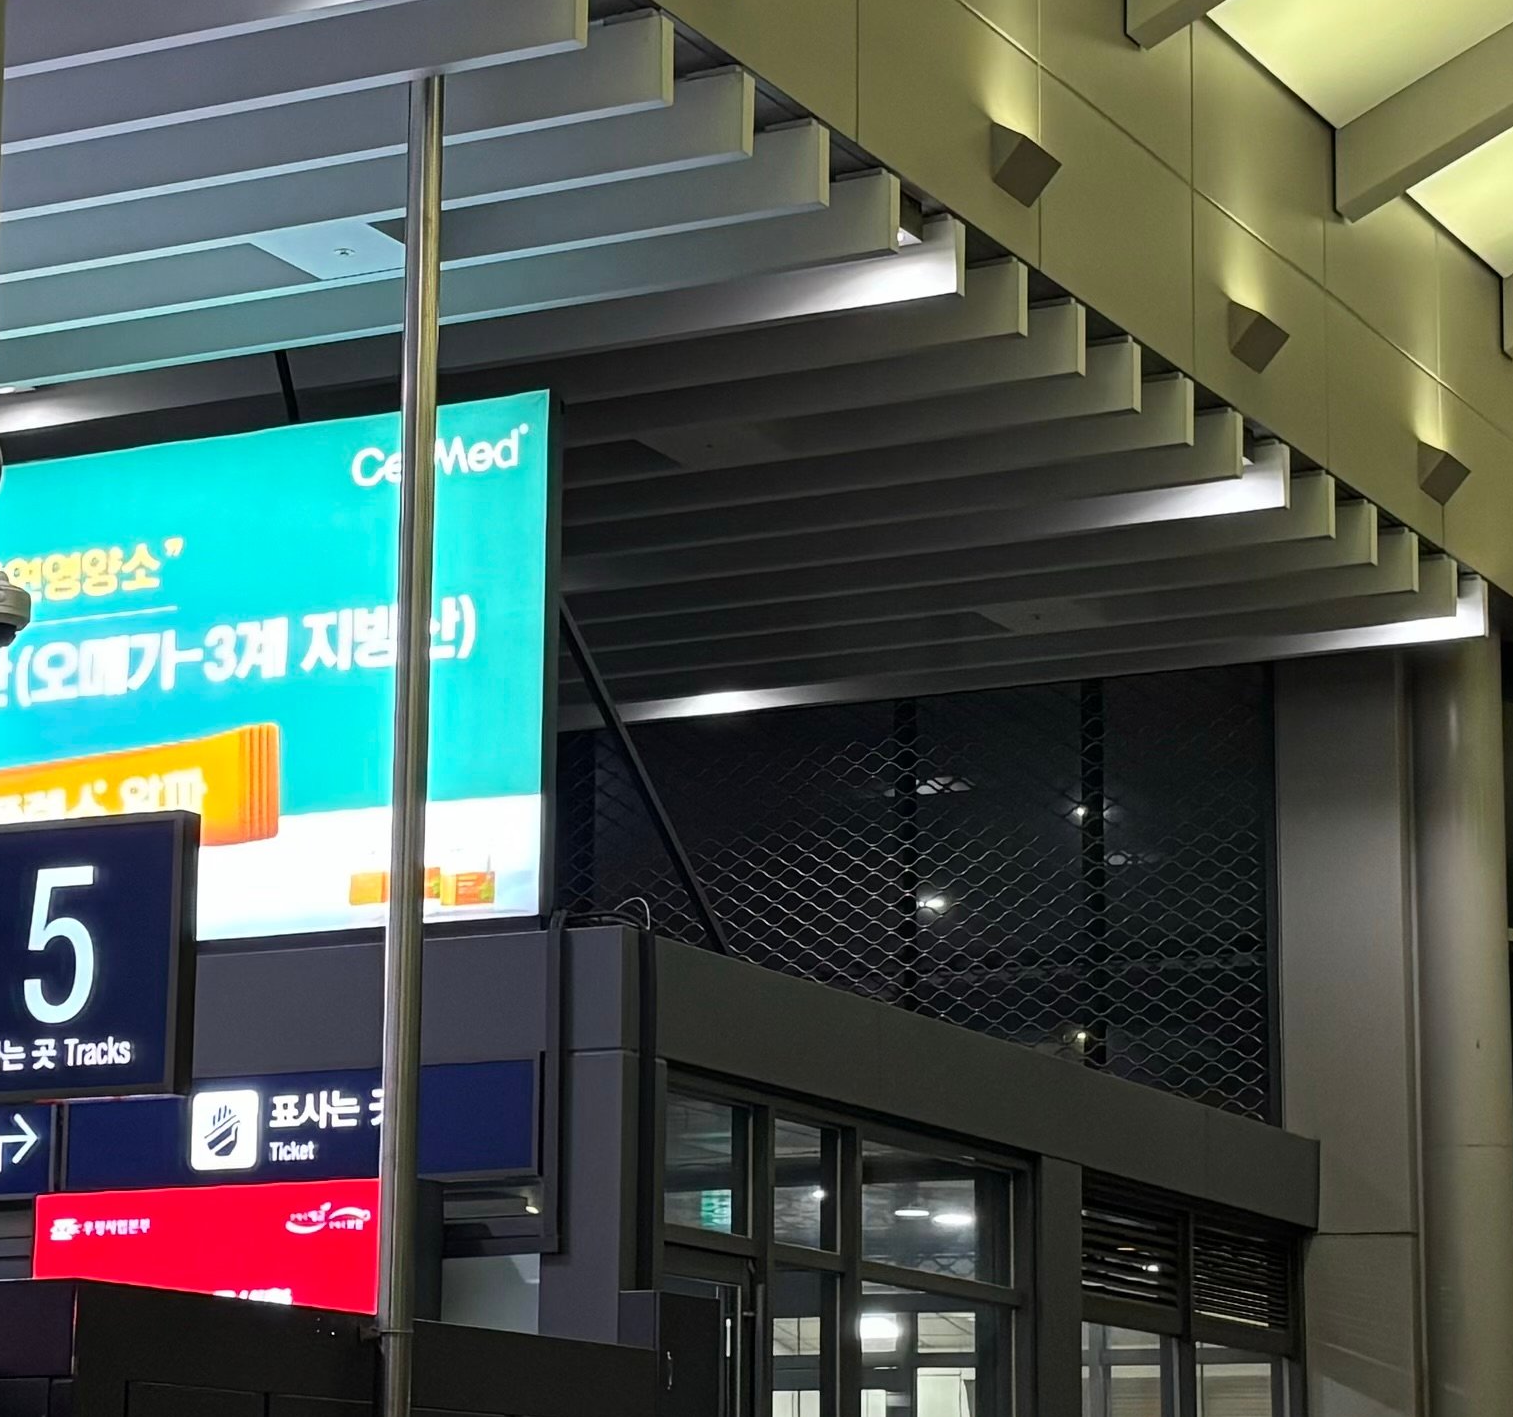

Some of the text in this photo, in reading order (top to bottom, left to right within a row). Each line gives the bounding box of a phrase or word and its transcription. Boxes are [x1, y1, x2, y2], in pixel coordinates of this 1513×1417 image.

[352, 423, 529, 488] CeMed
[23, 865, 94, 1024] 5
[32, 1038, 57, 1070] 곳
[64, 1036, 131, 1067] Tracks
[270, 1089, 360, 1130] 표사는
[269, 1140, 315, 1163] Ticket
